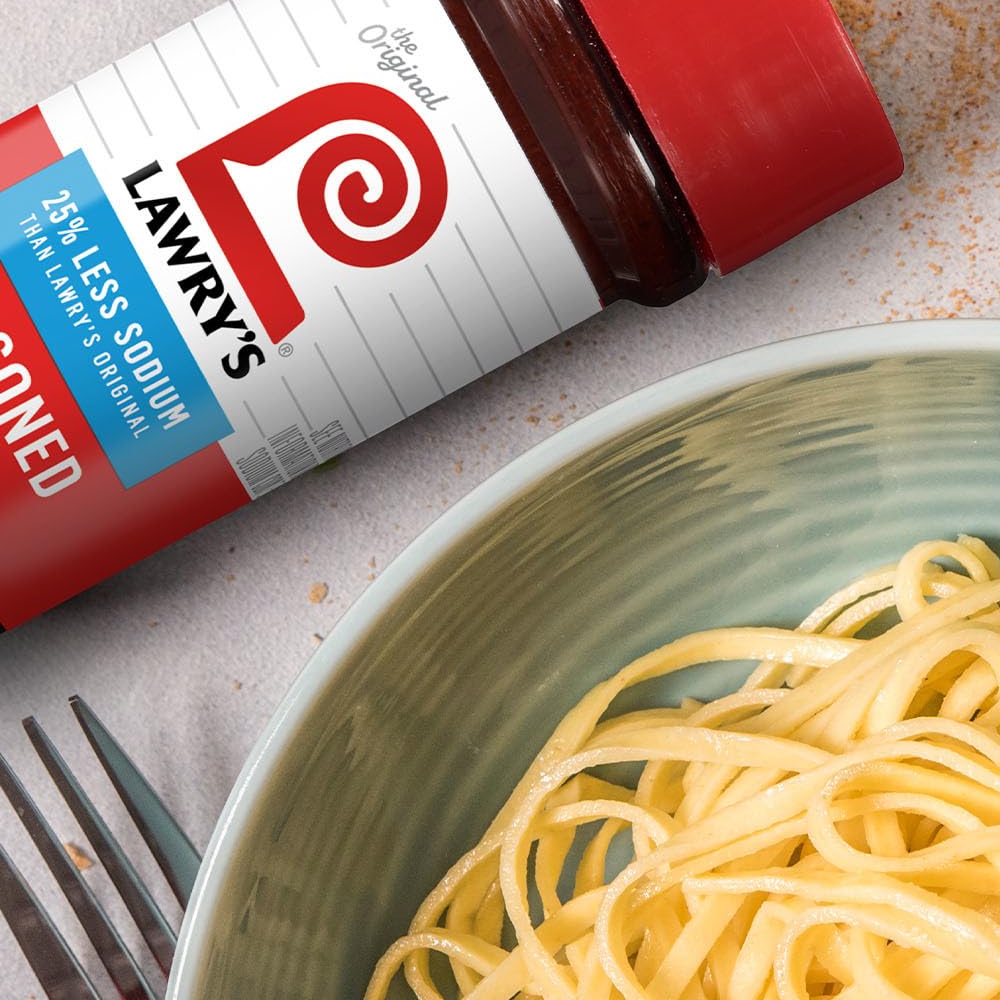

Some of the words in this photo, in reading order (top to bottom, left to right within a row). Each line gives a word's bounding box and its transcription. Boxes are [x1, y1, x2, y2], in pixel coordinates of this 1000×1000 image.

[358, 24, 449, 111] Original
[390, 27, 418, 55] the
[19, 213, 54, 262] THAN
[45, 264, 101, 348] LAWRY'S
[93, 352, 151, 440] ORIGINAL
[41, 189, 89, 245] 25%
[71, 244, 129, 319] LESS
[113, 322, 191, 431] SODIUM
[122, 160, 266, 379] LAWRY'S
[0, 331, 82, 498] ONED
